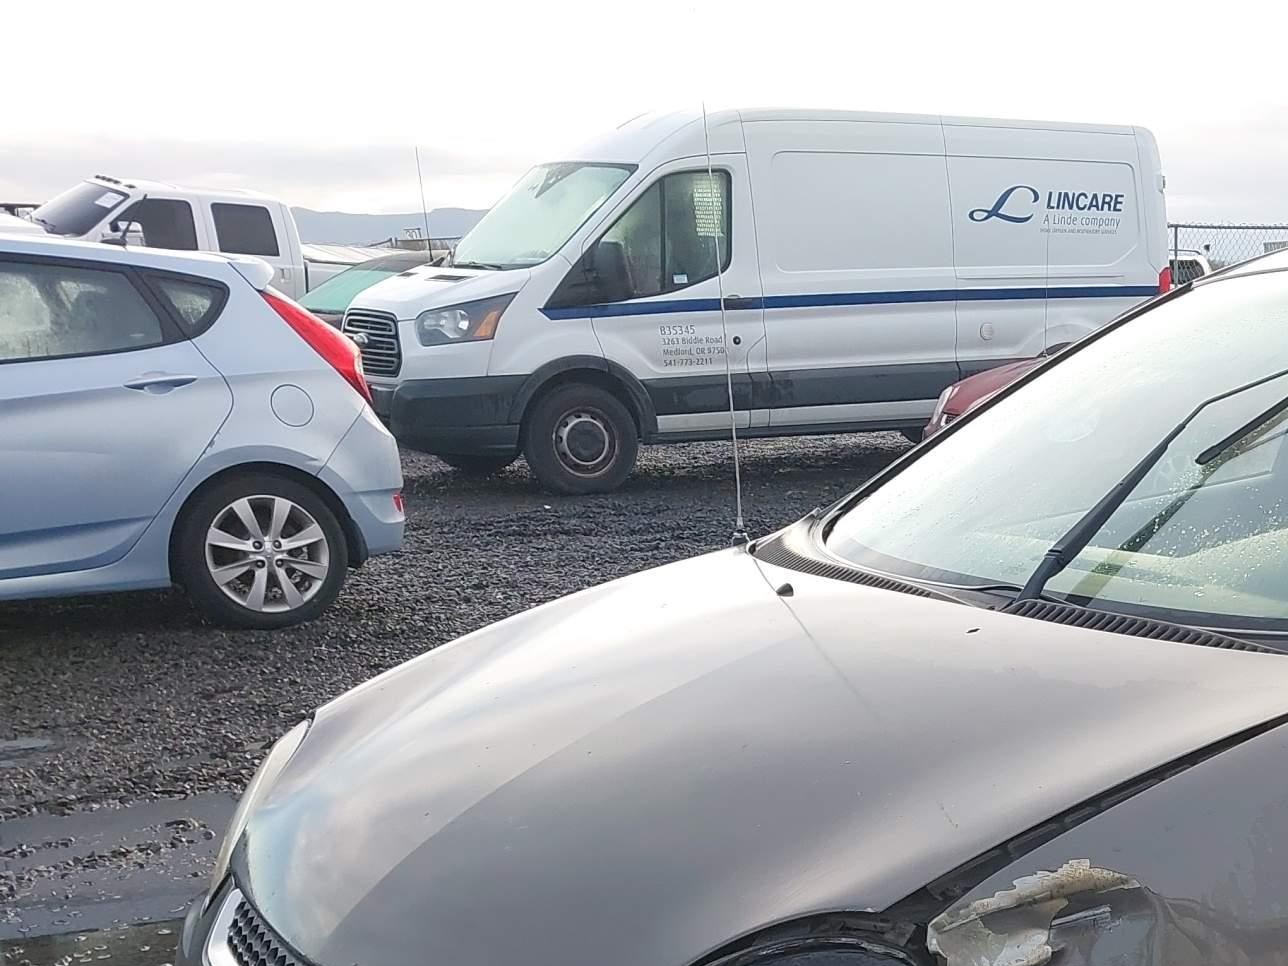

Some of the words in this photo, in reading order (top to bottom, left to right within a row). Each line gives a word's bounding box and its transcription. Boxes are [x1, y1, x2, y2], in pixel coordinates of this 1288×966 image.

[1046, 191, 1125, 212] LINCARE
[1043, 214, 1050, 225] A
[1053, 214, 1077, 226] Linde
[1080, 216, 1121, 229] company
[681, 336, 704, 344] Biddle
[705, 335, 723, 344] Road
[695, 347, 706, 355] OR
[664, 358, 712, 367] 541-773-2211
